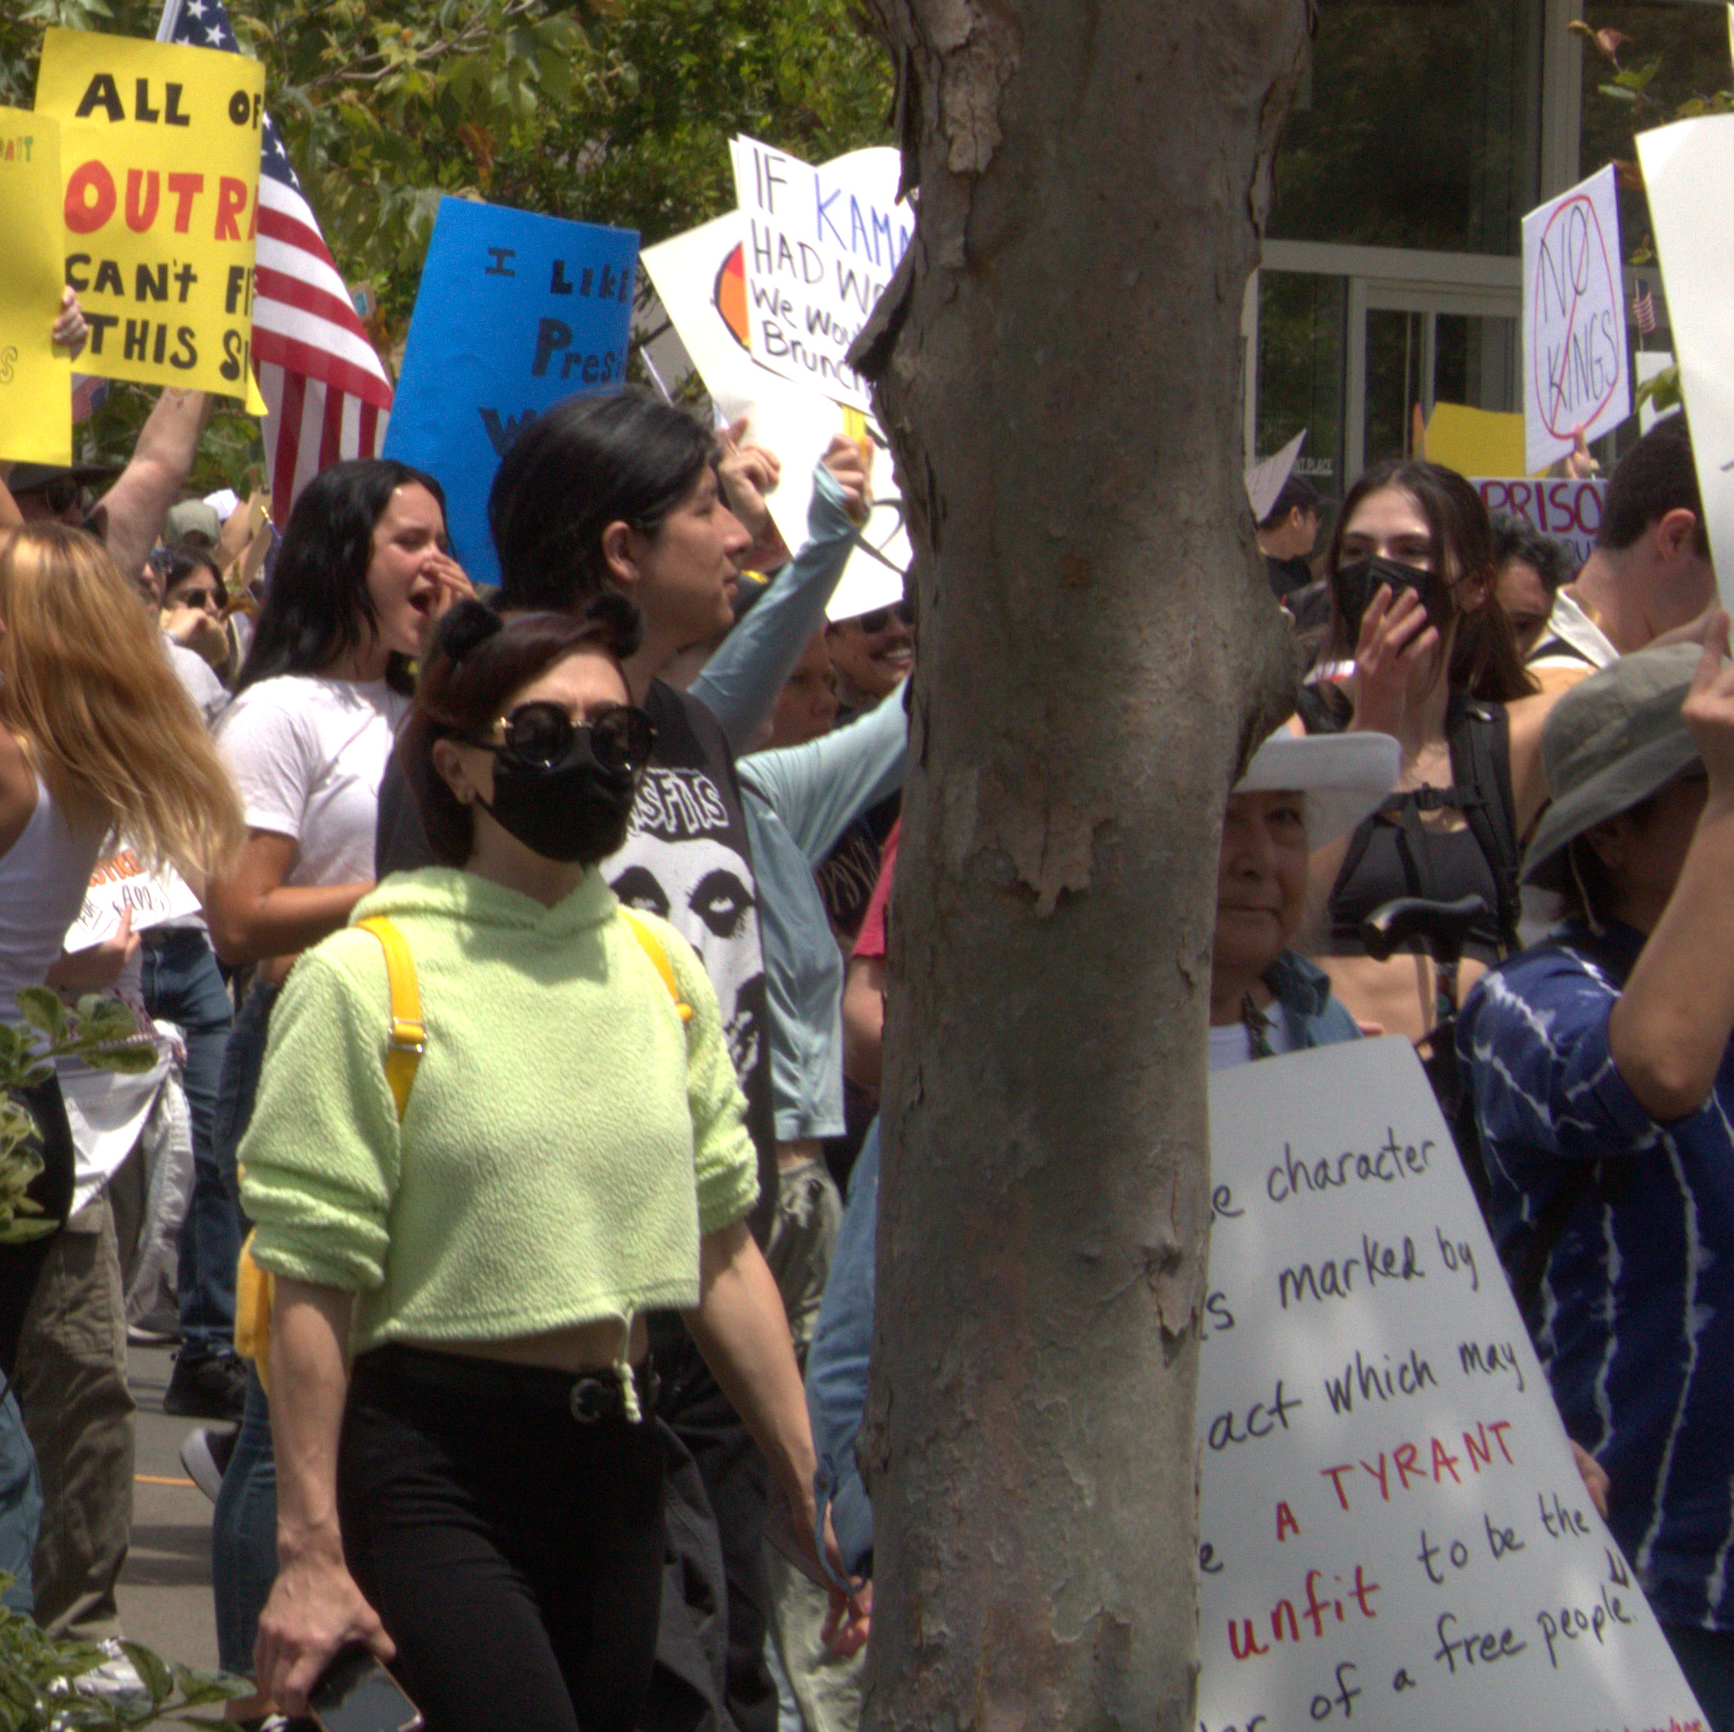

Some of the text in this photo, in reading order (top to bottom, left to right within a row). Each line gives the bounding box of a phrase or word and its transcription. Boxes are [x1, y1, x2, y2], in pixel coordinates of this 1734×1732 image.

[75, 73, 191, 127] ALL
[750, 218, 825, 285] HAD
[753, 146, 911, 275] IF KAMA
[484, 247, 516, 278] I
[749, 277, 798, 330] We
[1540, 204, 1590, 324] NO
[80, 311, 199, 371] THIS
[1547, 309, 1619, 428] KINGS
[1479, 480, 1603, 535] PRISO
[1266, 1126, 1437, 1204] character
[1279, 1232, 1426, 1313] marked
[1434, 1225, 1481, 1293] by
[1207, 1378, 1303, 1452] act
[1458, 1334, 1525, 1395] may
[1275, 1419, 1515, 1544] A TYRANT
[1417, 1527, 1469, 1589] to
[1483, 1511, 1527, 1558] be
[1537, 1490, 1593, 1542] the
[1228, 1564, 1383, 1665] unfit
[1310, 1661, 1362, 1724] of
[1392, 1666, 1417, 1695] a
[1432, 1612, 1530, 1673] free
